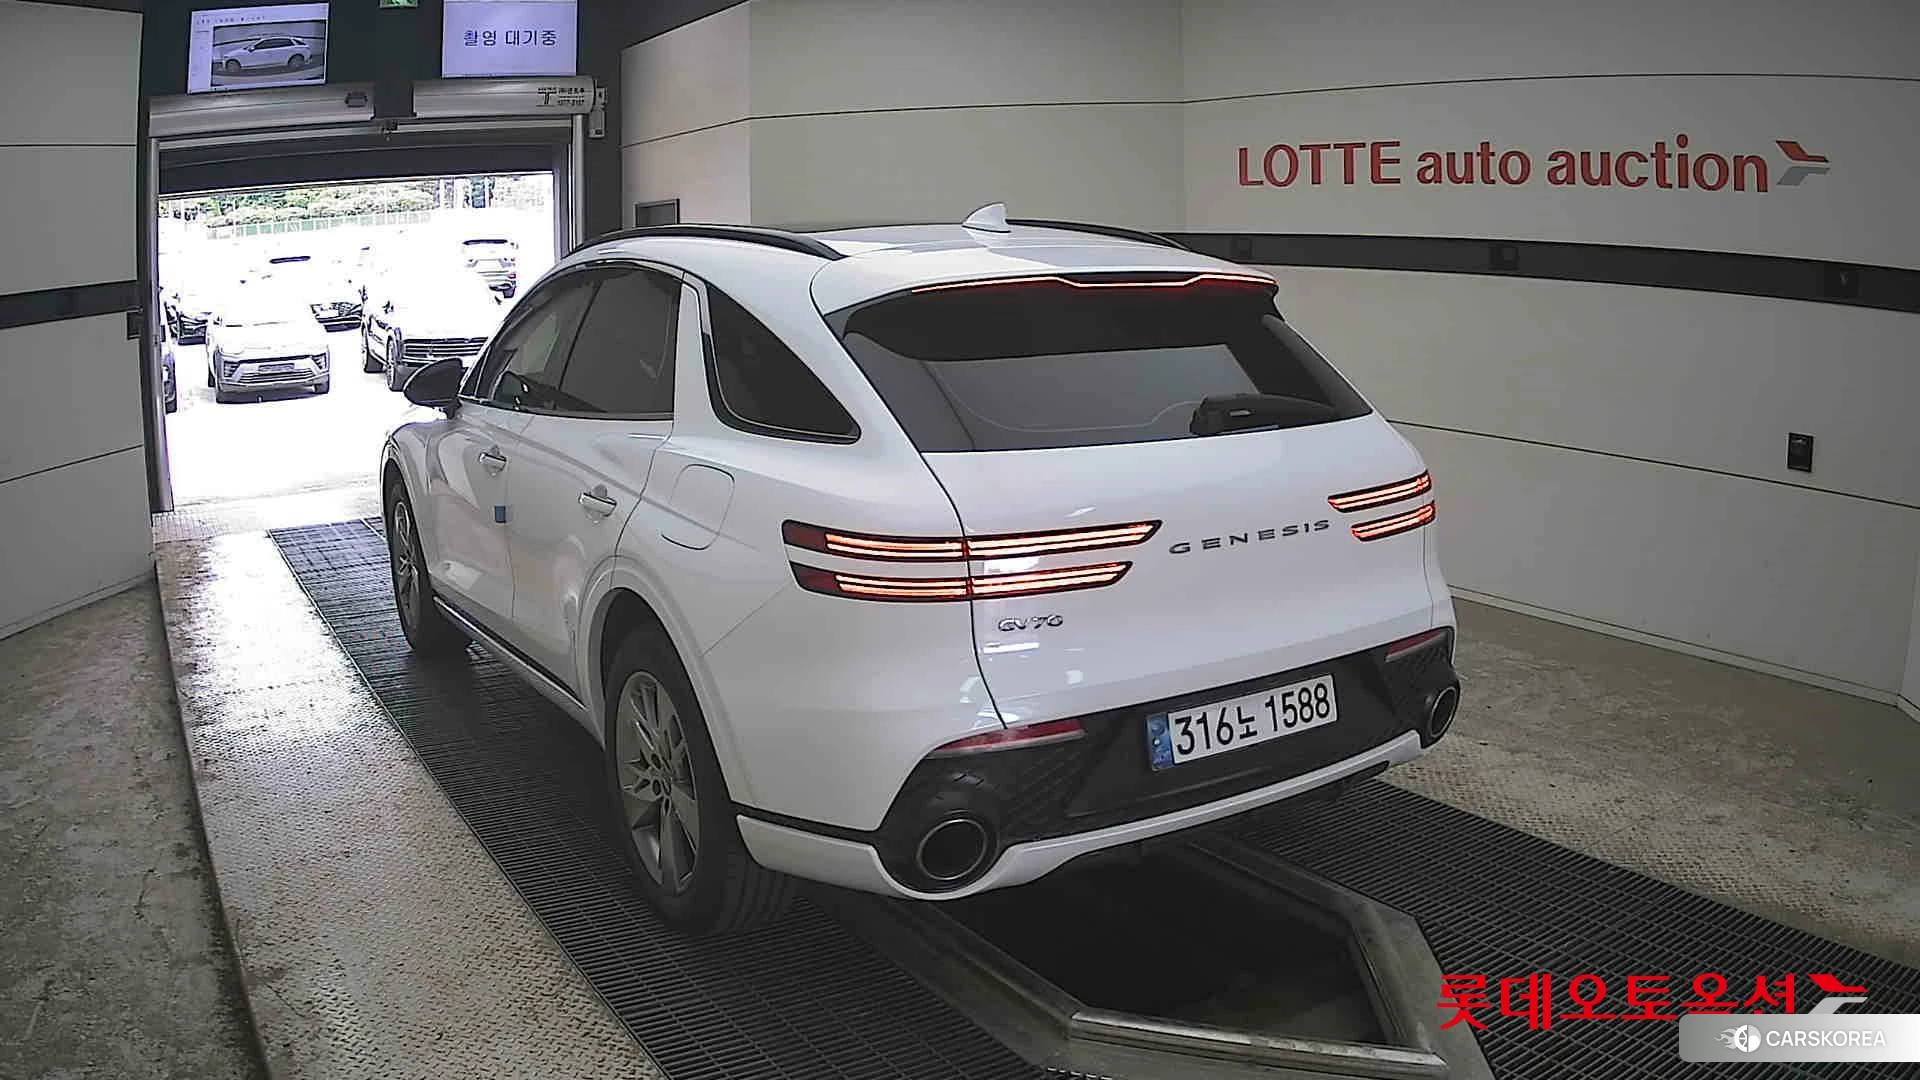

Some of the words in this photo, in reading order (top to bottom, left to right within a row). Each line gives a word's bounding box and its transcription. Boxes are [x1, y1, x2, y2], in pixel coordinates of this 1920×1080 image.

[463, 30, 497, 47] 촬영
[505, 29, 557, 46] 대기중
[1238, 140, 1401, 188] LOTTE
[1416, 141, 1531, 185] auto
[1547, 134, 1769, 193] auction
[1169, 519, 1330, 554] GENESIS
[998, 614, 1064, 632] GV70
[1174, 705, 1258, 756] 316노
[1264, 683, 1331, 732] 1588
